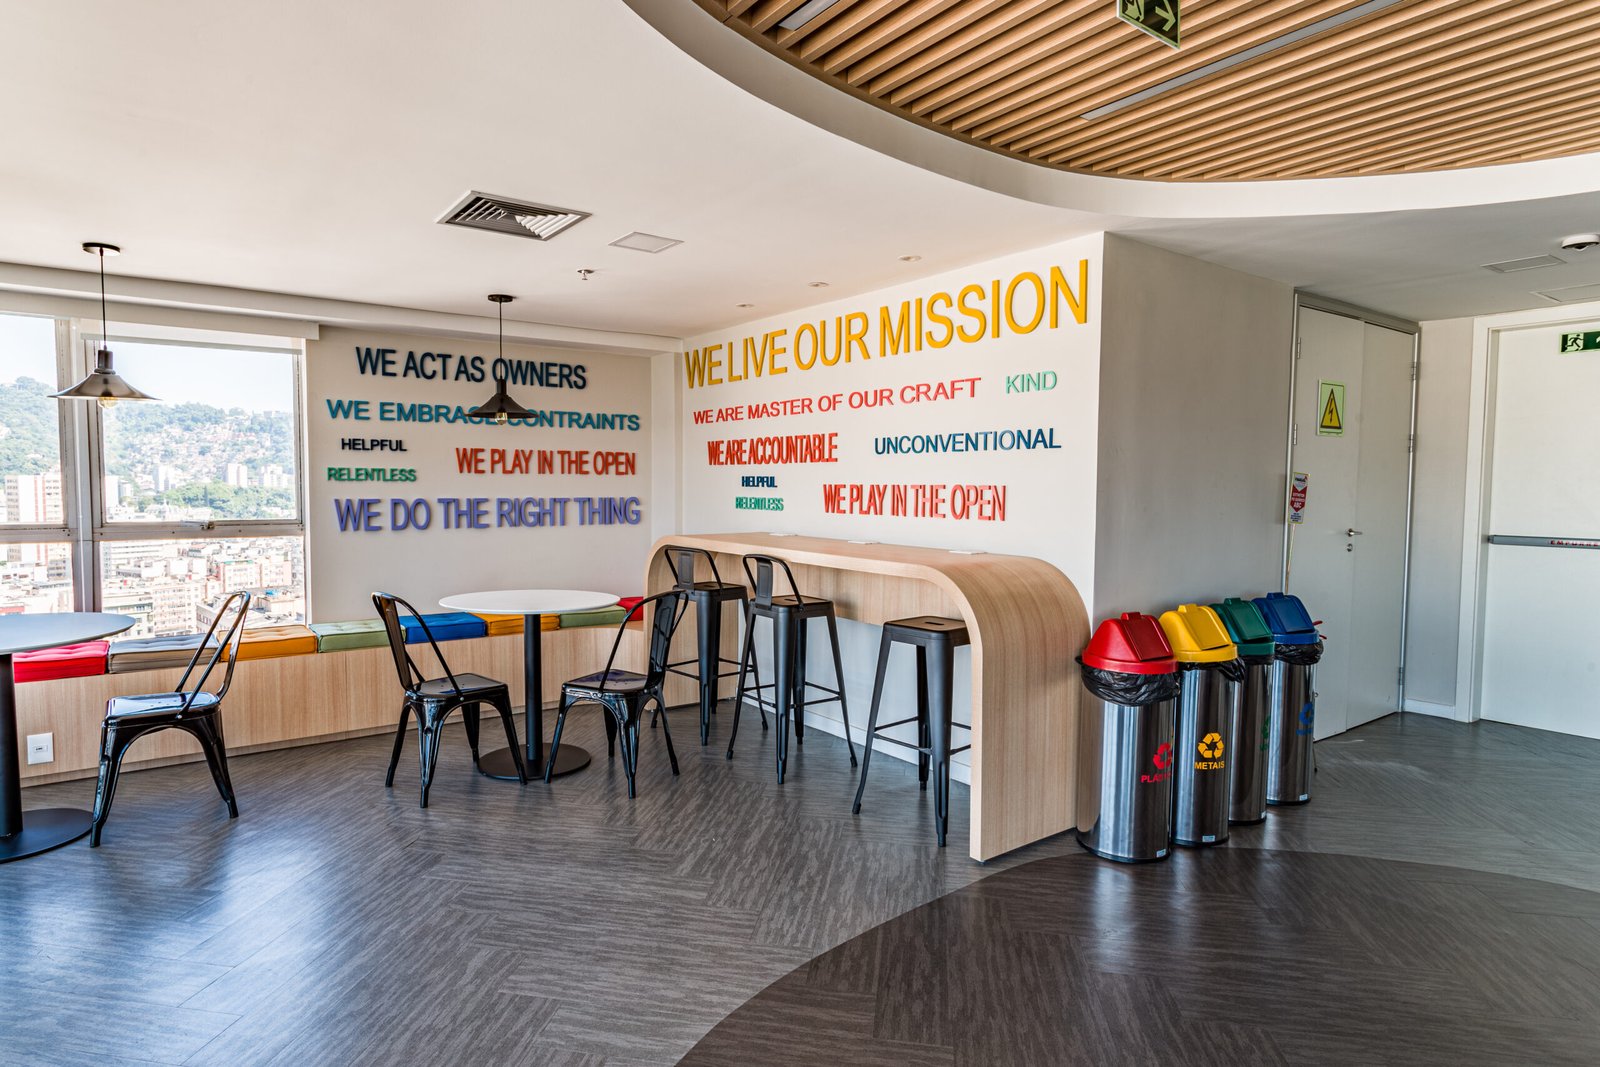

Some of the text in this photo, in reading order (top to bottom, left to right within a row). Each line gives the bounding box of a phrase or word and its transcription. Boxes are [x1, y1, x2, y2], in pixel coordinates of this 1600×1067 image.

[684, 258, 1089, 389] WE LIVE OUR MISSION
[355, 346, 587, 390] WE ACT AS OWNERS
[1006, 371, 1057, 394] KIND
[326, 398, 640, 431] WE EMBRAC ONTRAINTS
[693, 377, 982, 425] WE ARE MASTER OF OUR CRAFT
[341, 437, 407, 452] HELPFUL
[707, 433, 838, 466] WE ARE ACCOUNTABLE
[874, 428, 1062, 455] UNCONVENTIONAL
[327, 467, 417, 482] RELENTLESS
[455, 447, 636, 476] WE PLAY IN THE OPEN
[741, 476, 778, 488] HELPFUL
[334, 497, 641, 532] WE DO THE RIGHT THING
[735, 496, 784, 511] RELENTLESS
[823, 484, 1006, 521] WE PLAY IN THE OPEN
[1194, 761, 1225, 770] METAIS
